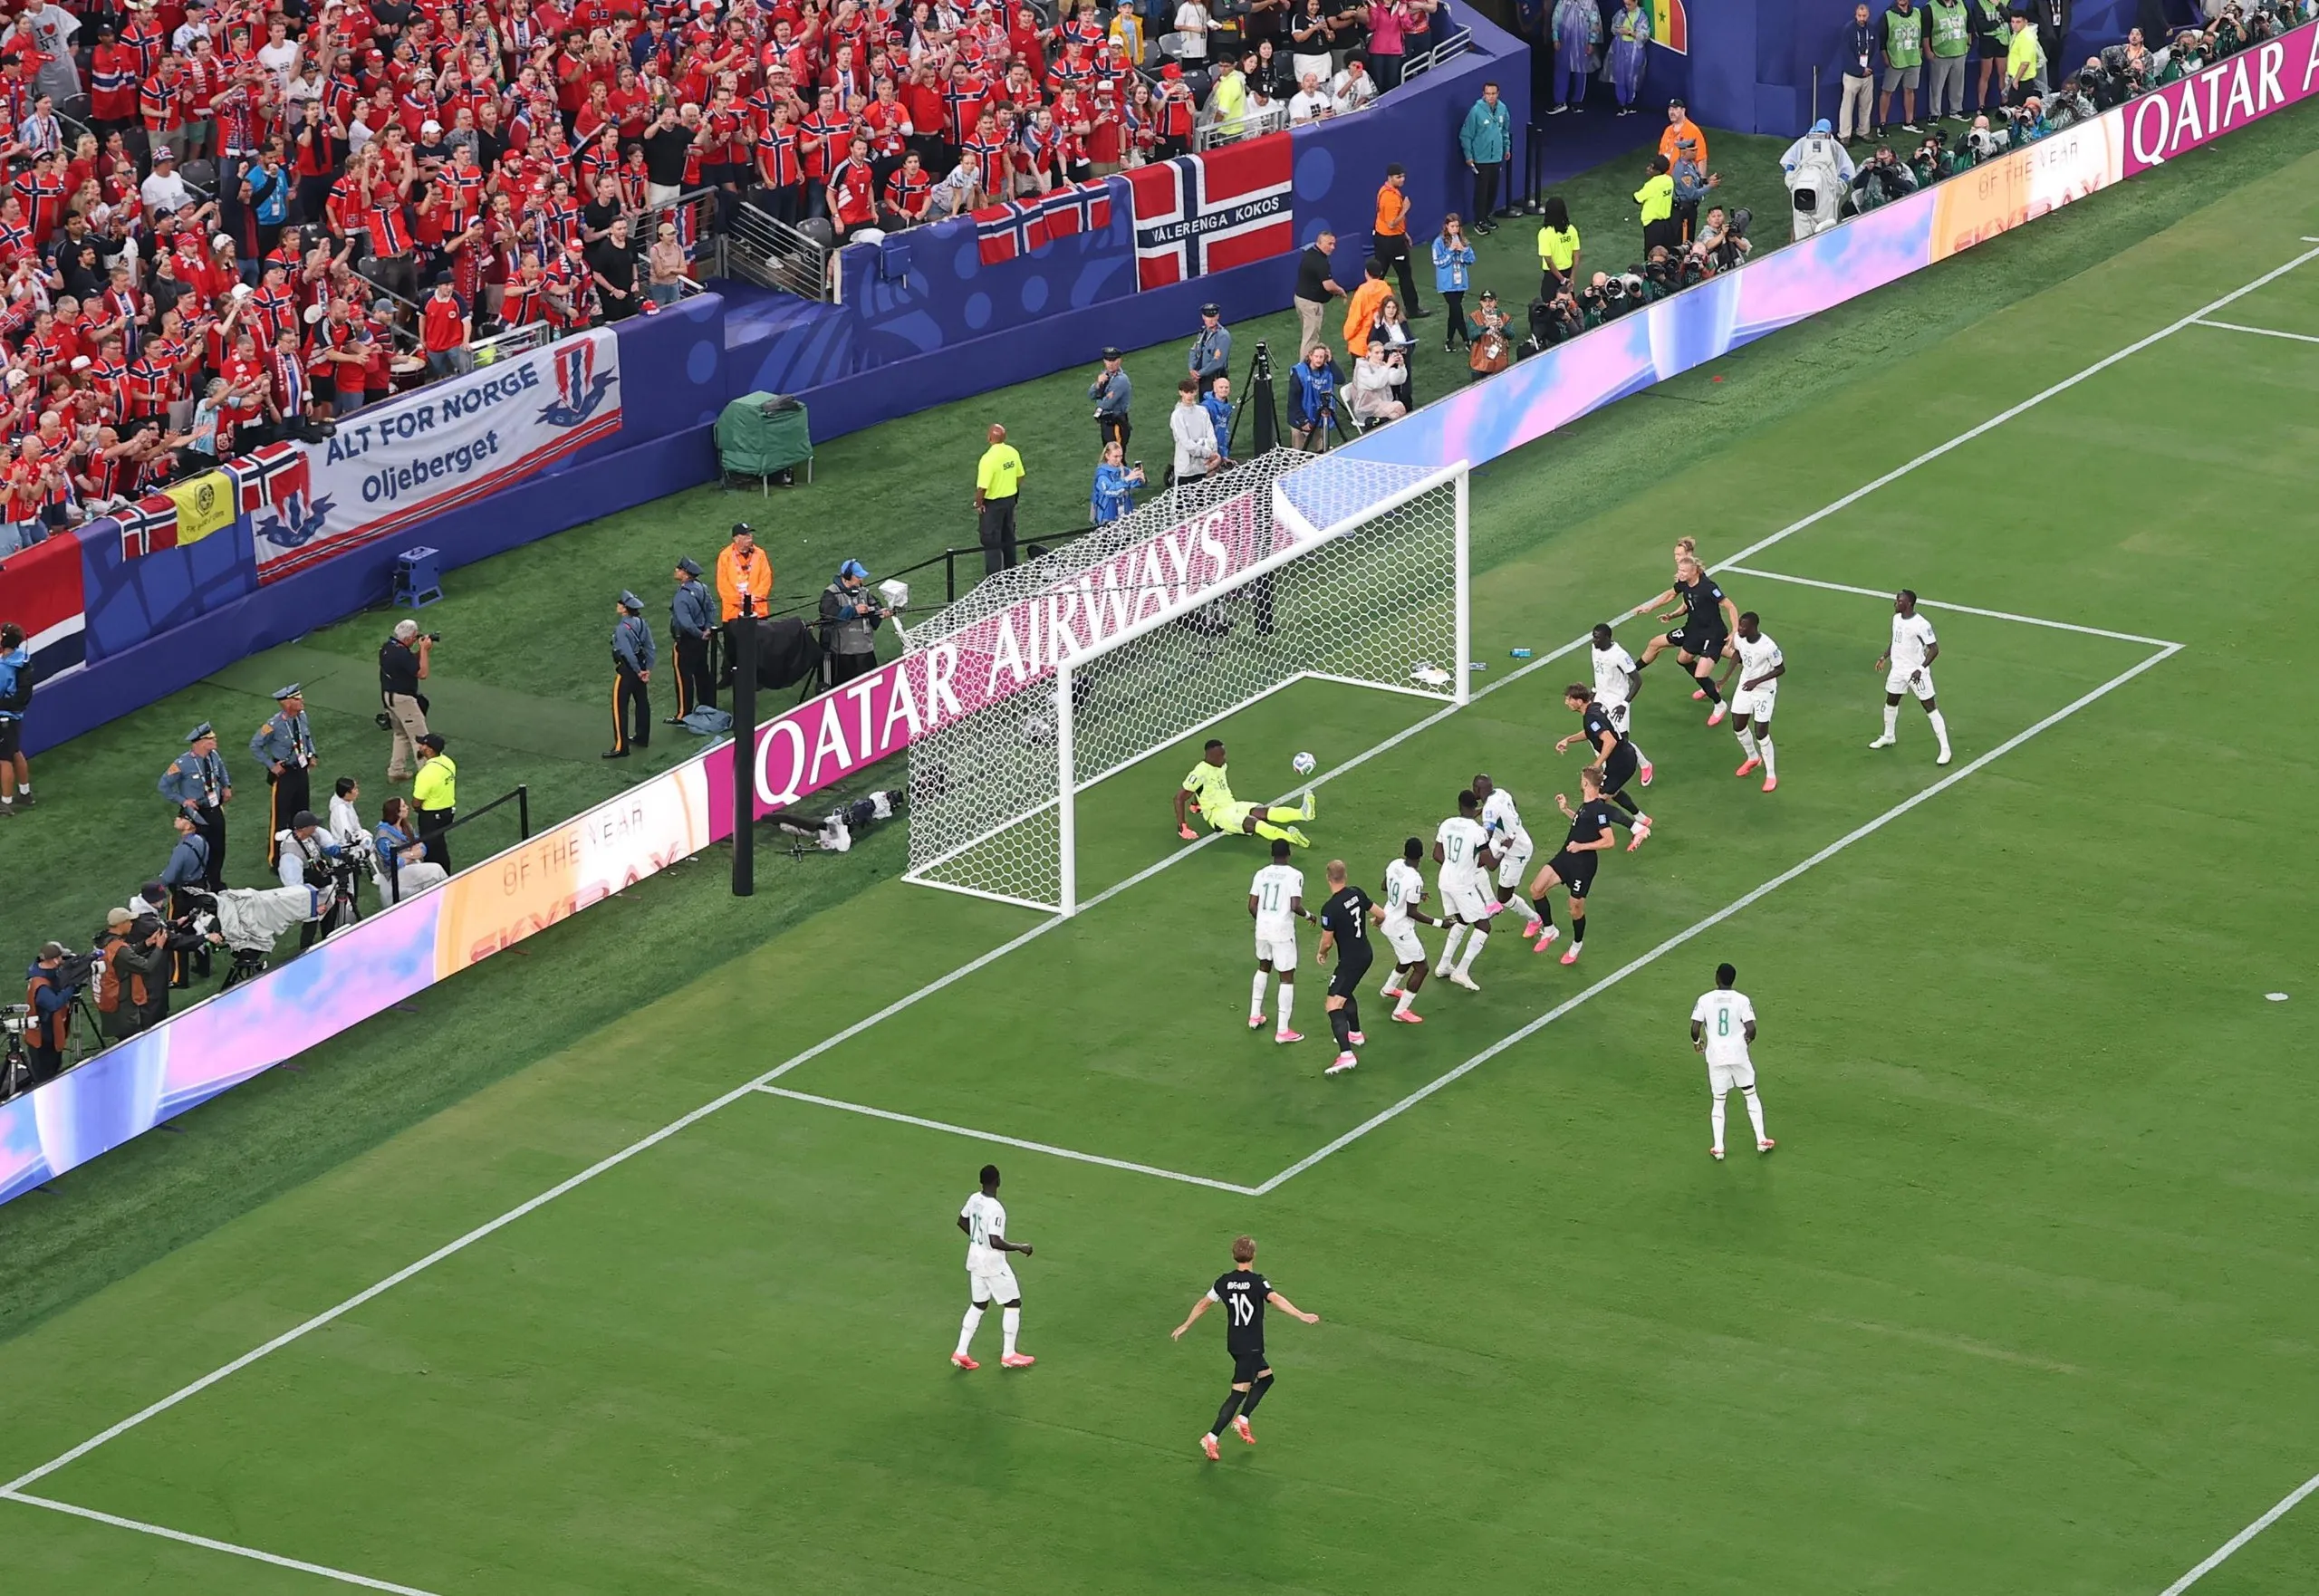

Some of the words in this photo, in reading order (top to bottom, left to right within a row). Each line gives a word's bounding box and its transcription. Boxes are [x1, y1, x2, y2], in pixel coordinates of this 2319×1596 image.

[2132, 42, 2285, 166] QATAR
[1235, 197, 1280, 222] KOKOS
[326, 426, 371, 466] ALT
[380, 406, 435, 446] FOR
[443, 362, 540, 424] NORGE
[362, 429, 498, 504] Oljeberget
[755, 642, 963, 805] QATAR
[986, 511, 1227, 698] AIRWAYS
[1447, 834, 1463, 863] 19
[1263, 882, 1280, 911] 11
[1573, 880, 1583, 892] 3
[1350, 906, 1362, 938] 7
[1718, 1007, 1728, 1036] 8
[1228, 1293, 1255, 1326] 10
